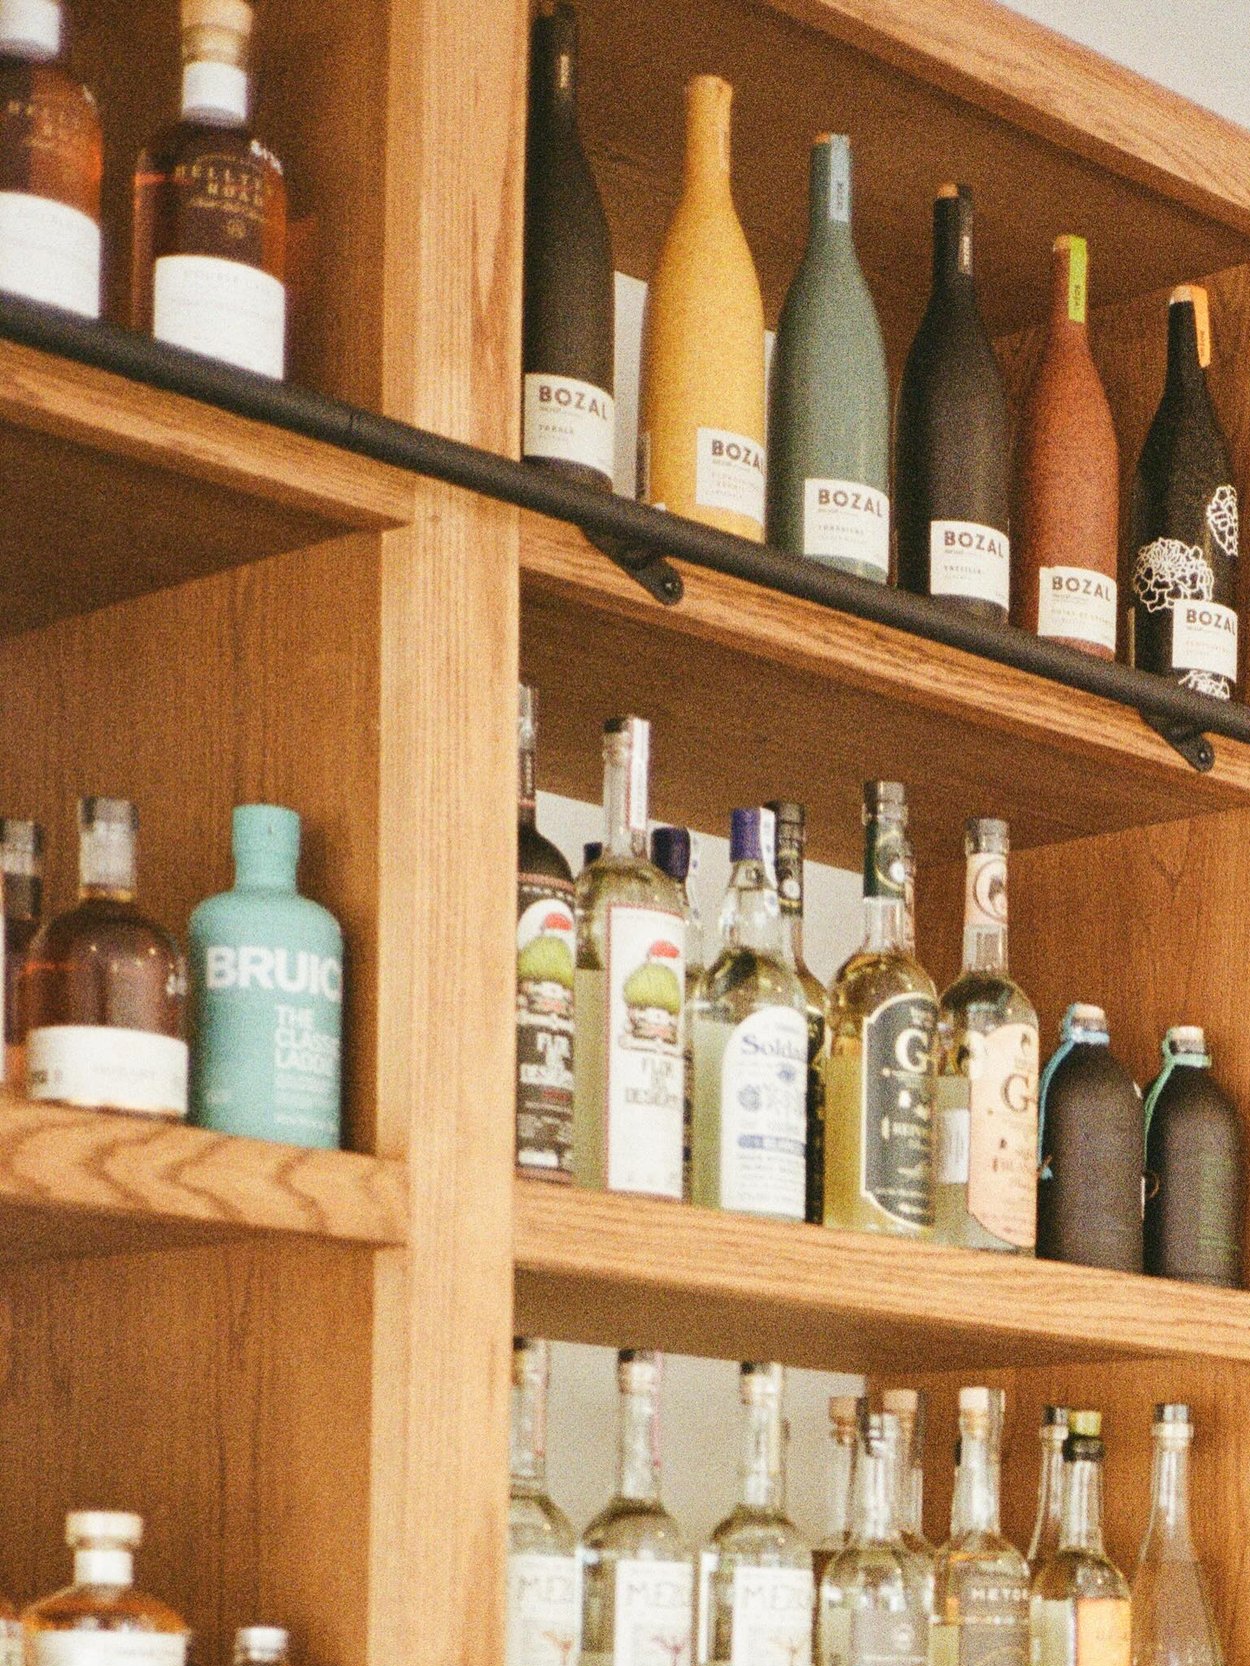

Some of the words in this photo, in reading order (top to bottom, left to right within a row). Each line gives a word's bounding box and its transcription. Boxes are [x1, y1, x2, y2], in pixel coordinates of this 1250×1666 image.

[538, 385, 607, 421] BOZAL
[818, 488, 883, 519] BOZAL
[944, 530, 1004, 559] BOZAL
[1052, 576, 1112, 602] BOZAL
